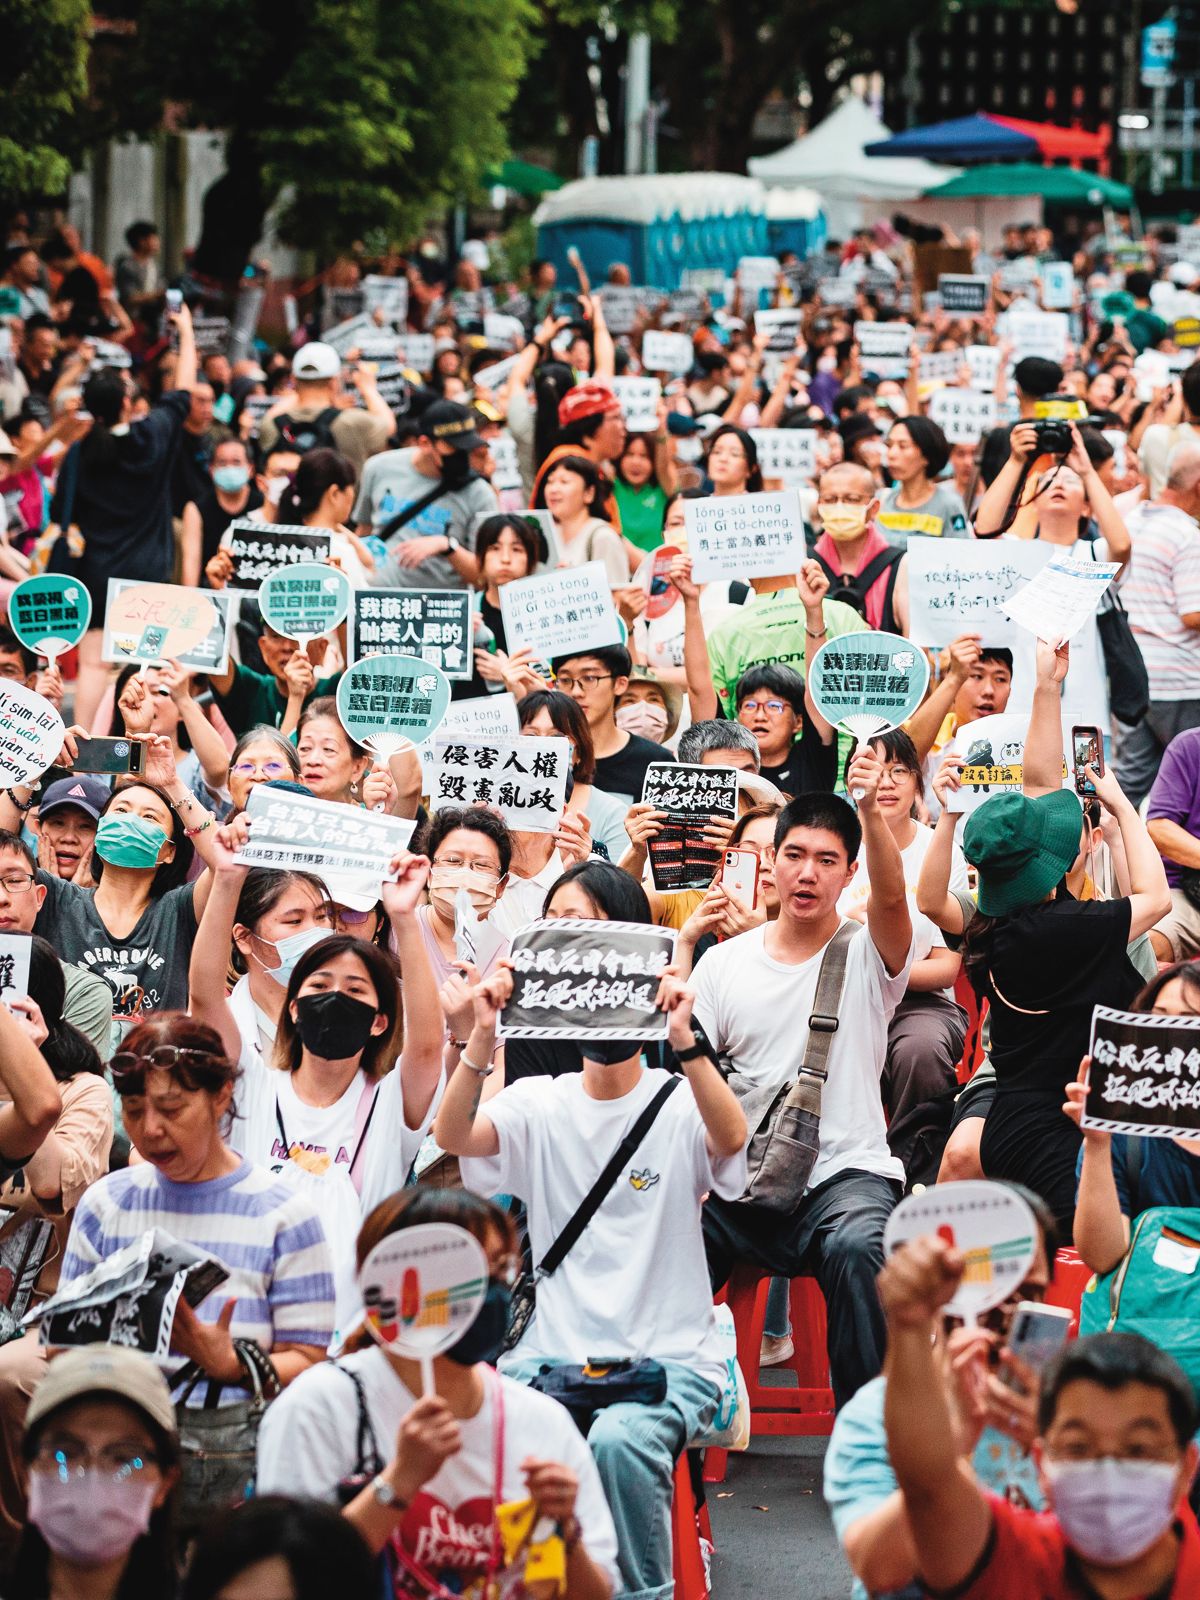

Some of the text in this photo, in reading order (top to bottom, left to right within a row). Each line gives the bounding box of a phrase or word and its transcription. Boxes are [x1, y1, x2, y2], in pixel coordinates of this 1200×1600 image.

[360, 597, 422, 620] 我藐視
[359, 621, 462, 644] 訕笑人民的
[823, 653, 890, 671] 我藐視
[351, 673, 414, 693] 我藐視
[821, 674, 909, 693] 藍白黑箱
[348, 693, 432, 714] 藍白黑箱
[442, 745, 558, 778] 侵害人權
[438, 772, 557, 813] 毀憲亂政
[334, 1146, 350, 1163] A
